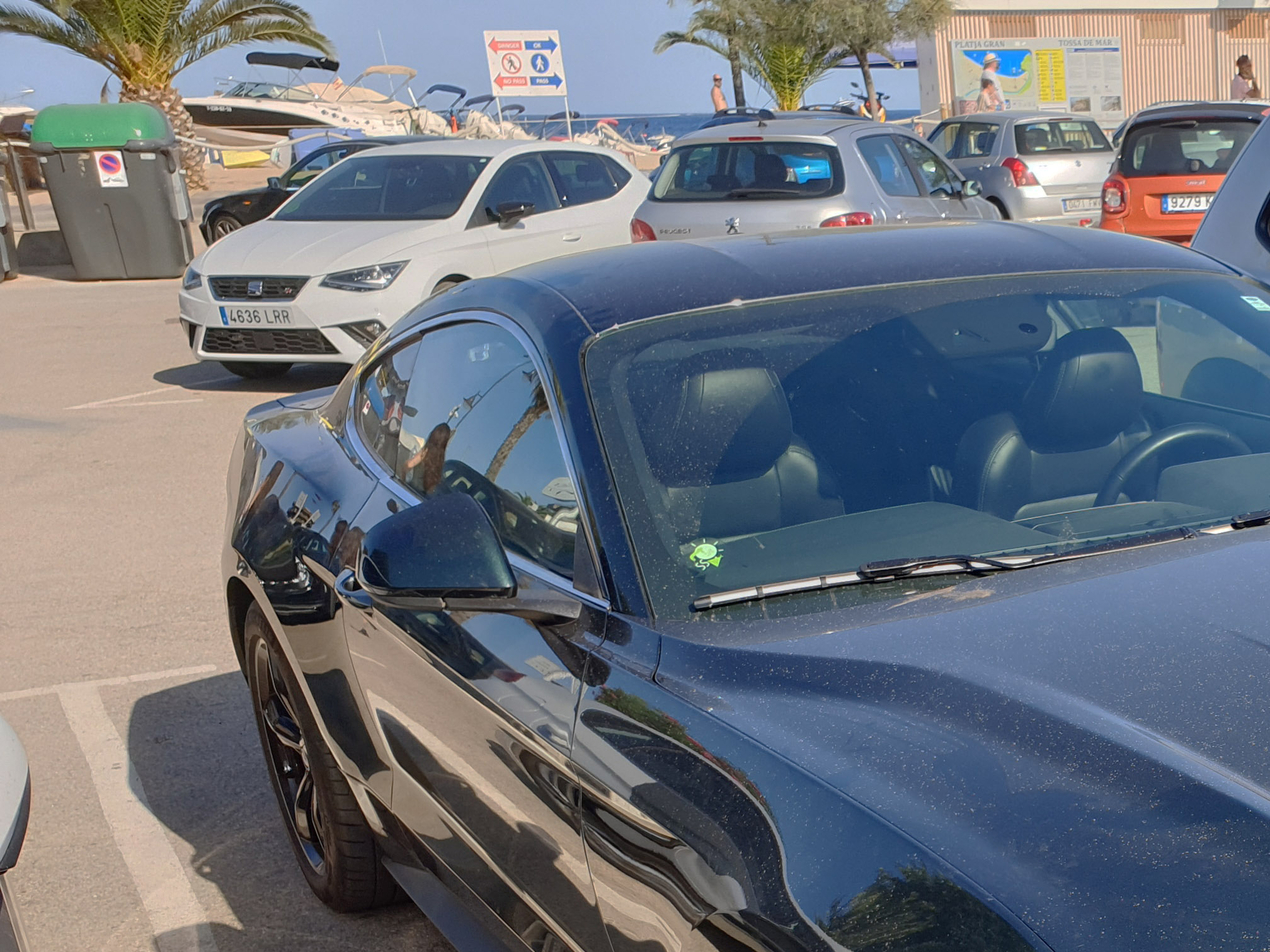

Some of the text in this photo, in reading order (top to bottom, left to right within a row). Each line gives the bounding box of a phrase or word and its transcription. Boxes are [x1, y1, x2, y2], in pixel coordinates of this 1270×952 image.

[1058, 39, 1082, 47] TOSSA
[1171, 194, 1200, 209] 9279
[230, 309, 291, 324] 4636 LRR
